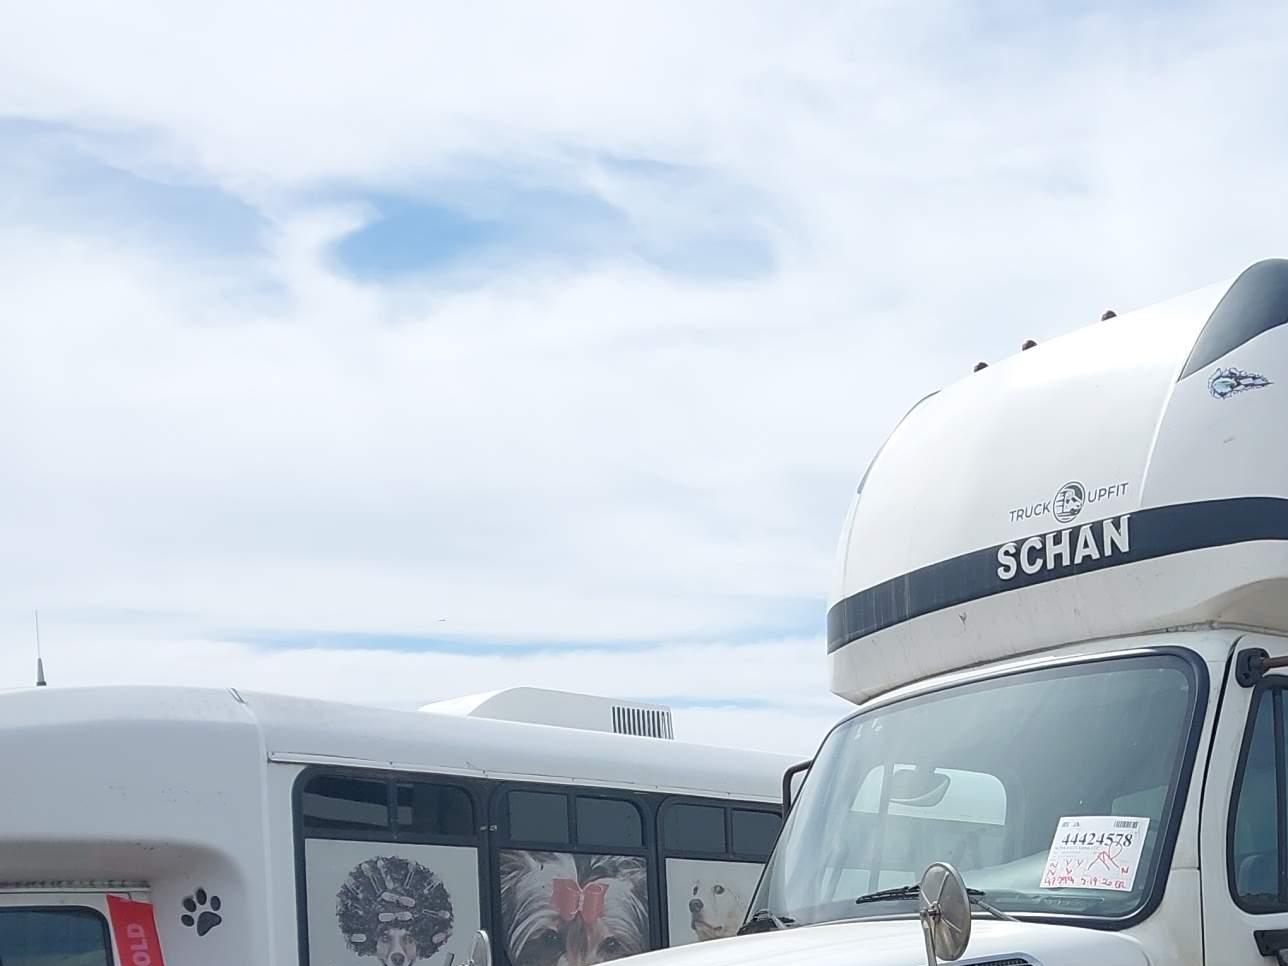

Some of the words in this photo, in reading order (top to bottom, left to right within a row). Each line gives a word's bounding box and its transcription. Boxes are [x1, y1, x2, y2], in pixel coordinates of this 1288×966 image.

[1009, 501, 1051, 523] TRUCK
[1088, 482, 1129, 503] UPFIT
[997, 514, 1131, 580] SCHAN
[1061, 832, 1133, 848] 44424578
